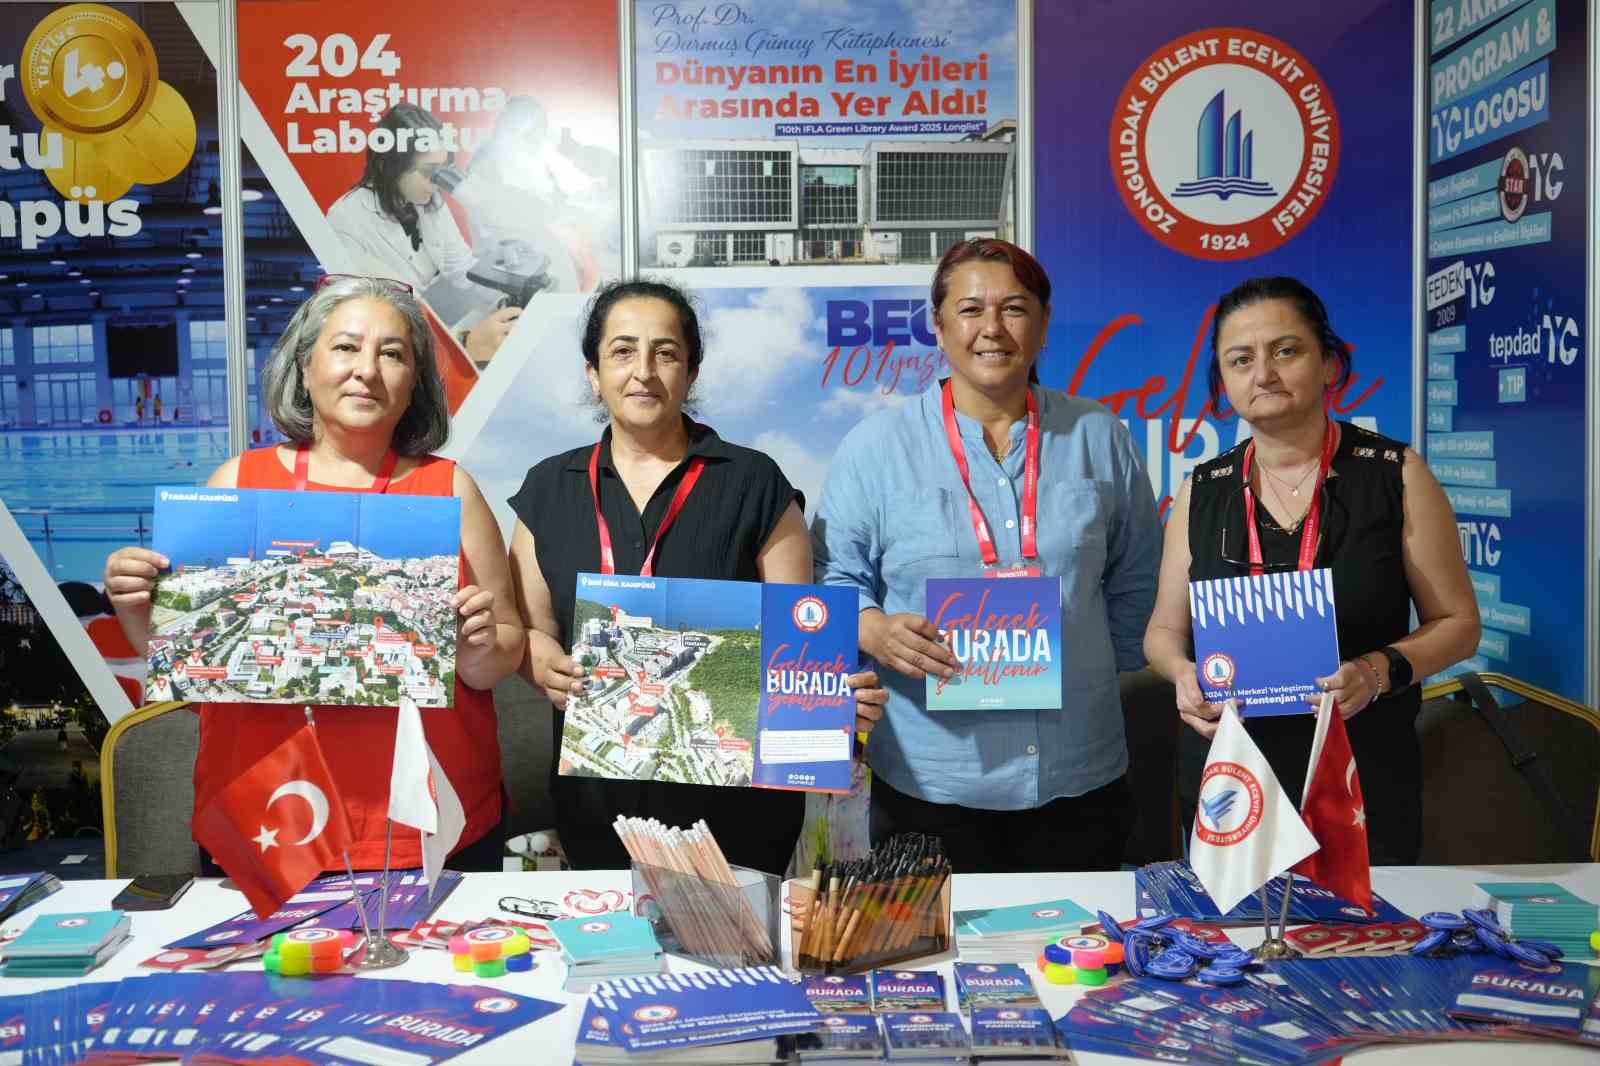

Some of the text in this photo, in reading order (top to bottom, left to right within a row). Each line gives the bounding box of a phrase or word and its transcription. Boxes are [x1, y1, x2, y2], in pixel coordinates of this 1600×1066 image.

[651, 3, 755, 33] Prof. Dr.
[283, 33, 401, 77] 204
[655, 26, 953, 58] Durmuş Günay Kütüphanesi
[1434, 7, 1551, 104] PROGRAM &
[656, 51, 988, 90] Dünyanın En İyileri
[284, 82, 508, 123] Araştırma
[655, 89, 987, 120] Arasında Yer Aldı!
[1463, 73, 1546, 139] LOGOSU
[777, 125, 801, 135] "10th
[802, 125, 824, 134] IFLA
[825, 125, 854, 134] Green
[855, 123, 890, 136] Library
[889, 123, 918, 133] Award
[919, 122, 942, 132] 2025
[1120, 38, 1331, 236] ZONGULDAK BÜLENT ECEVİT ÜNİVERSİTESİ
[1505, 178, 1524, 193] STAR
[1199, 233, 1250, 250] 1924
[1428, 267, 1464, 301] FEDEK
[1436, 305, 1456, 327] 2009
[1488, 325, 1542, 364] tepdad
[766, 669, 851, 697] BURADA
[1246, 694, 1297, 705] Kontenjan
[806, 987, 864, 996] BURADA
[878, 984, 936, 994] BURADA
[965, 977, 1024, 987] BURADA
[1472, 974, 1585, 1001] BURADA
[384, 1013, 486, 1047] BURADA
